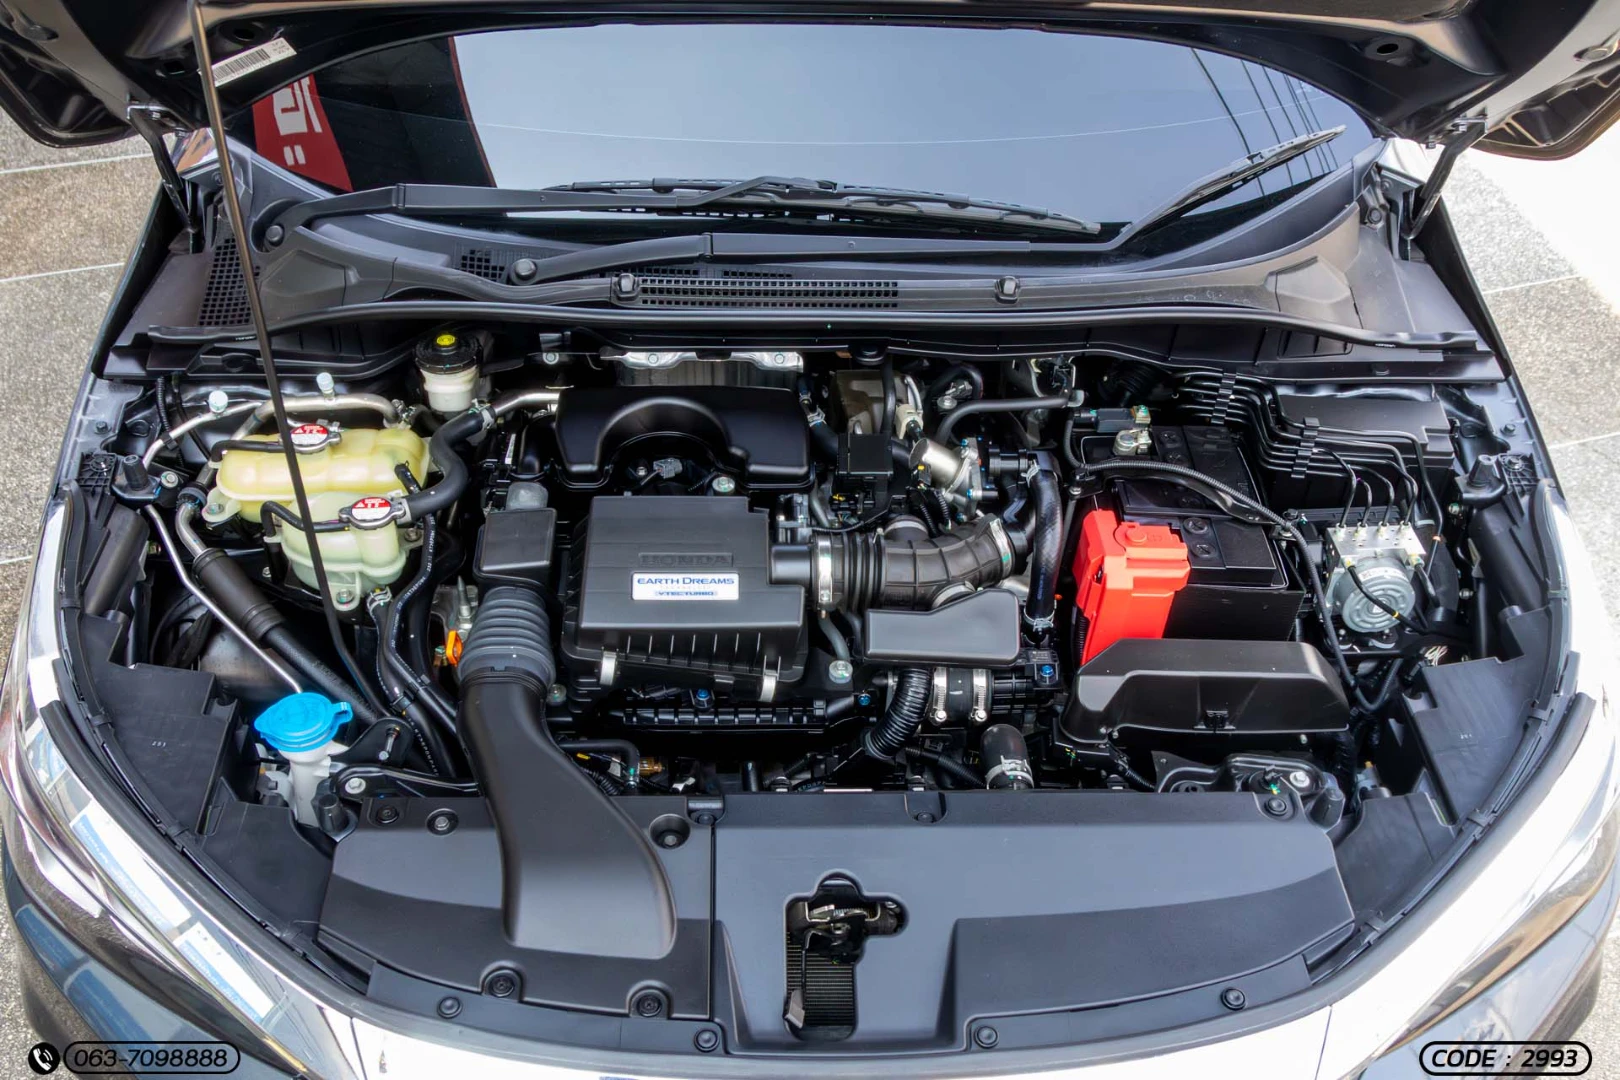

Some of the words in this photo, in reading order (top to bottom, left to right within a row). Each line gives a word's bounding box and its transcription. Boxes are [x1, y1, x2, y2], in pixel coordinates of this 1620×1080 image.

[641, 555, 729, 567] HONDA
[637, 577, 680, 585] EARTH
[682, 576, 735, 585] DREAMS
